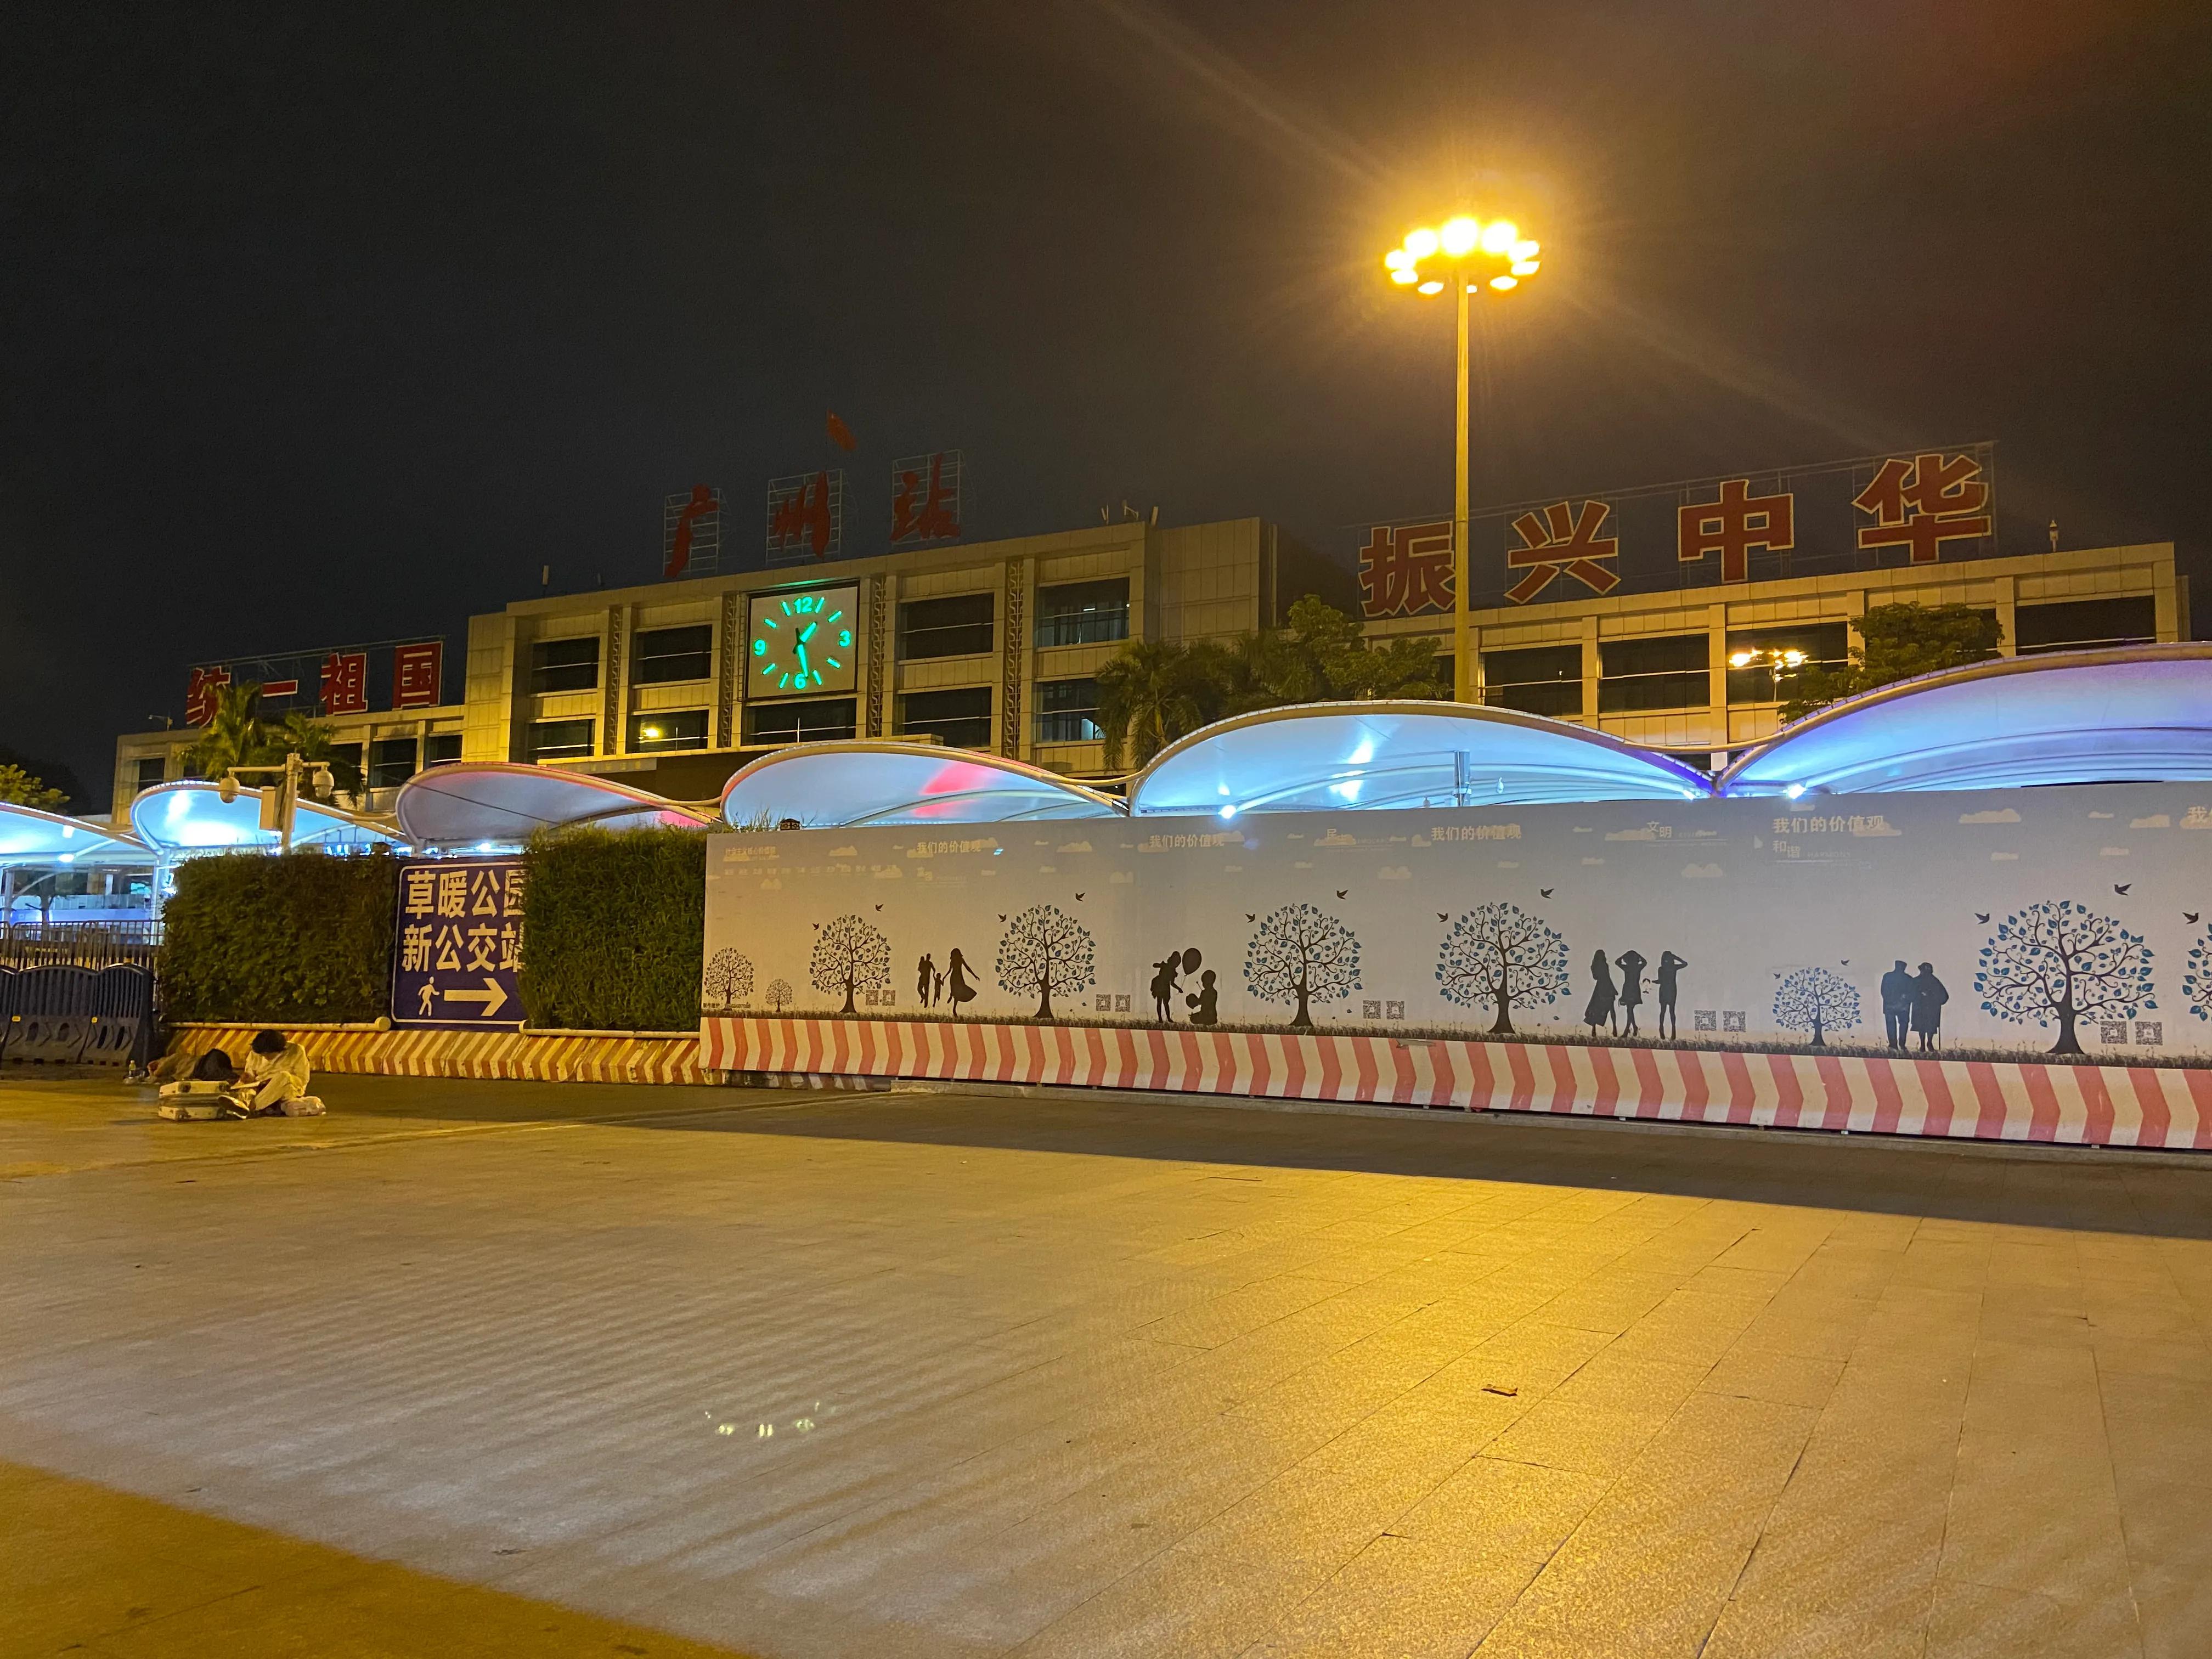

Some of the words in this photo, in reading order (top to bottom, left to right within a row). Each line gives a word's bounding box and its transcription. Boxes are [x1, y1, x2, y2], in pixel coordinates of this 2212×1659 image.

[664, 453, 961, 578] 广州站
[1358, 454, 1991, 617] 振兴中华
[794, 596, 813, 613] 12
[839, 630, 851, 647] 3
[754, 639, 766, 656] 9
[794, 673, 807, 690] 6
[1431, 823, 1522, 842] 我们的价值观
[1646, 821, 1672, 838] 文明
[1773, 815, 1884, 834] 我们的价值观
[916, 840, 982, 854] 我们的价值观
[1149, 833, 1225, 848] 我们的价值观
[1773, 840, 1801, 858] 和谐
